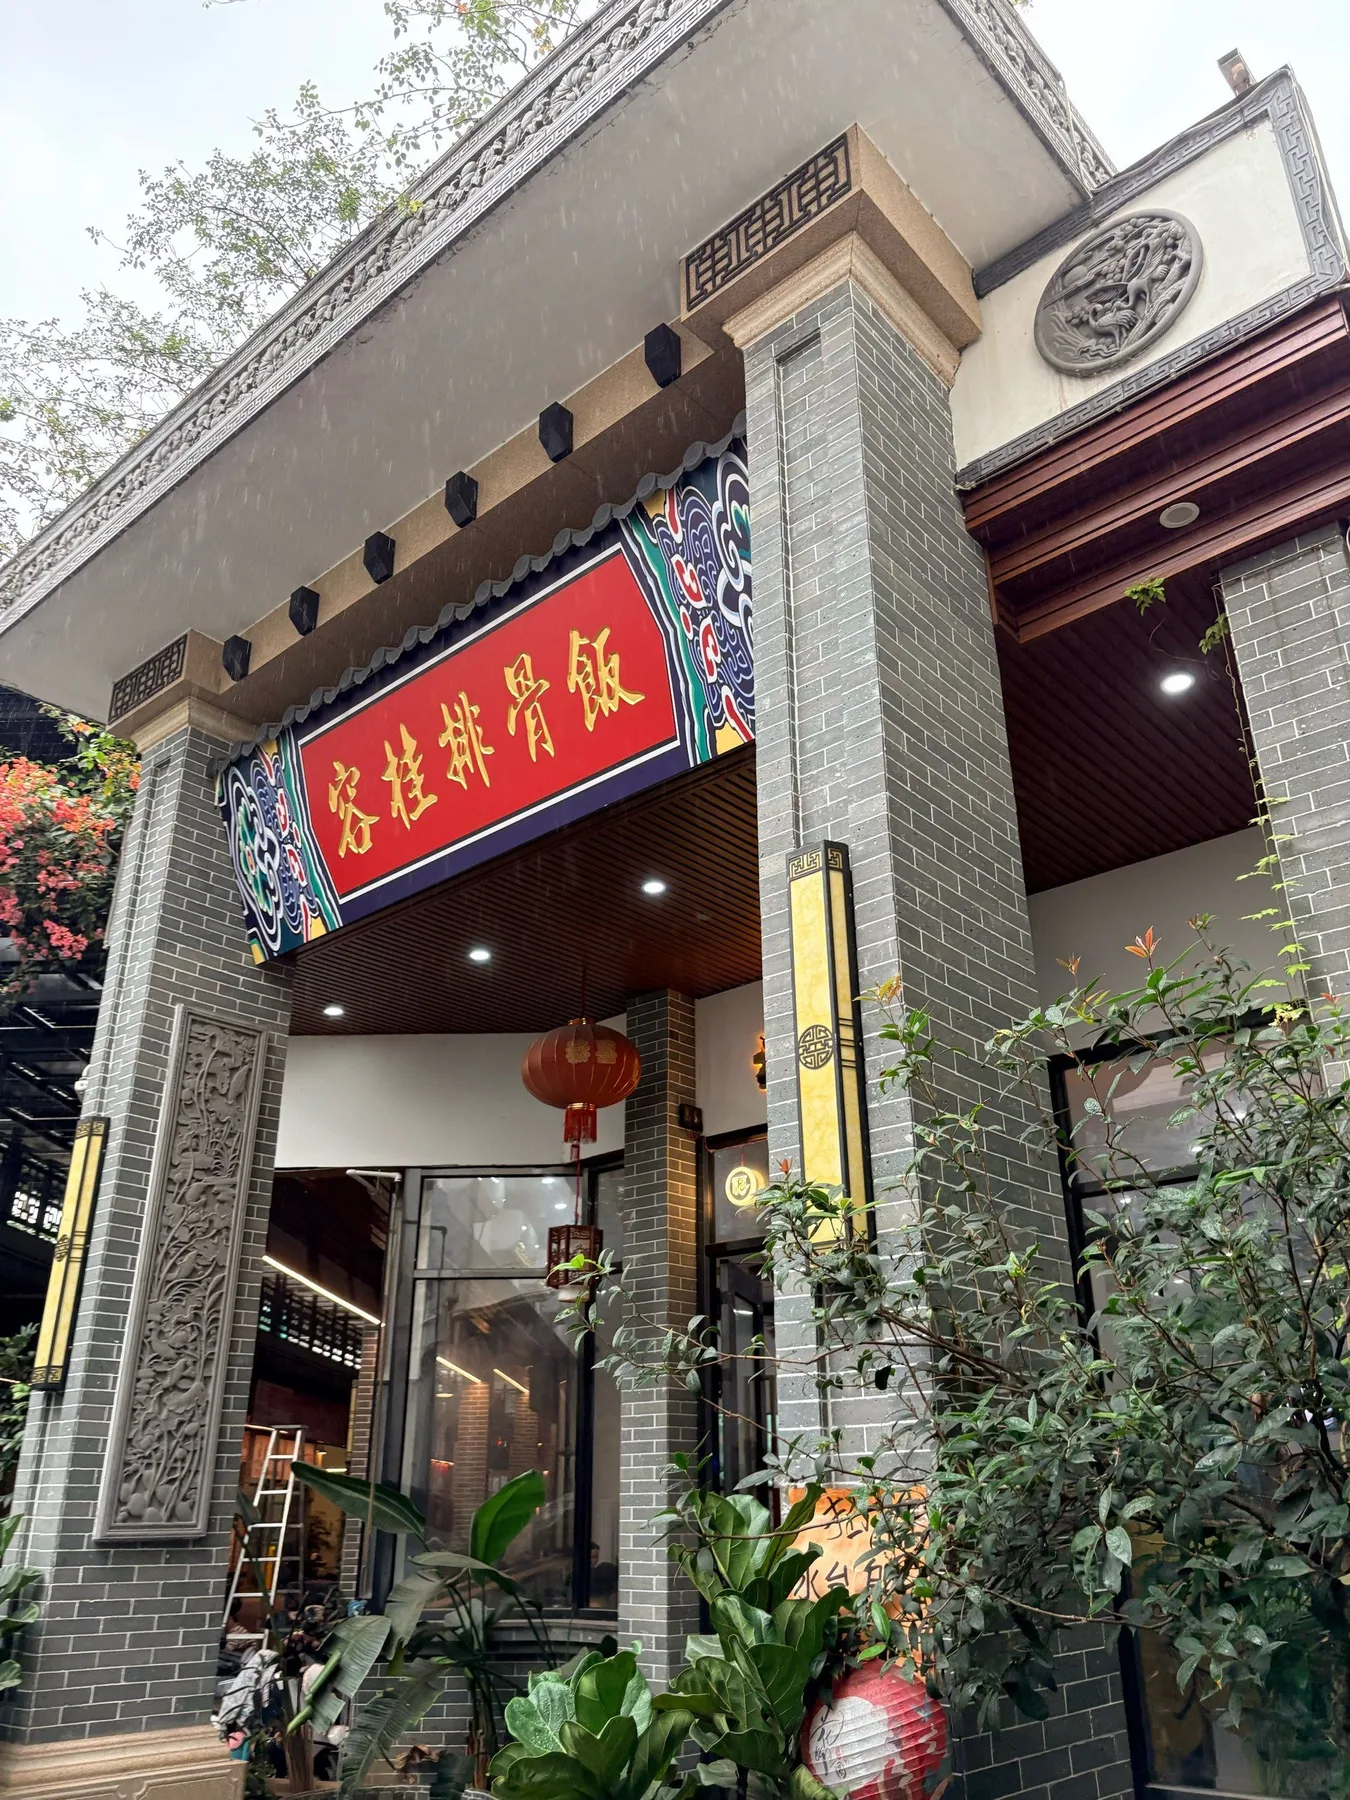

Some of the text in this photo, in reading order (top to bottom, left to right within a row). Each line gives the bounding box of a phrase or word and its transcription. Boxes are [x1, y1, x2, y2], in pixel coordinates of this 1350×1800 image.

[328, 625, 646, 859] 容桂排骨飯
